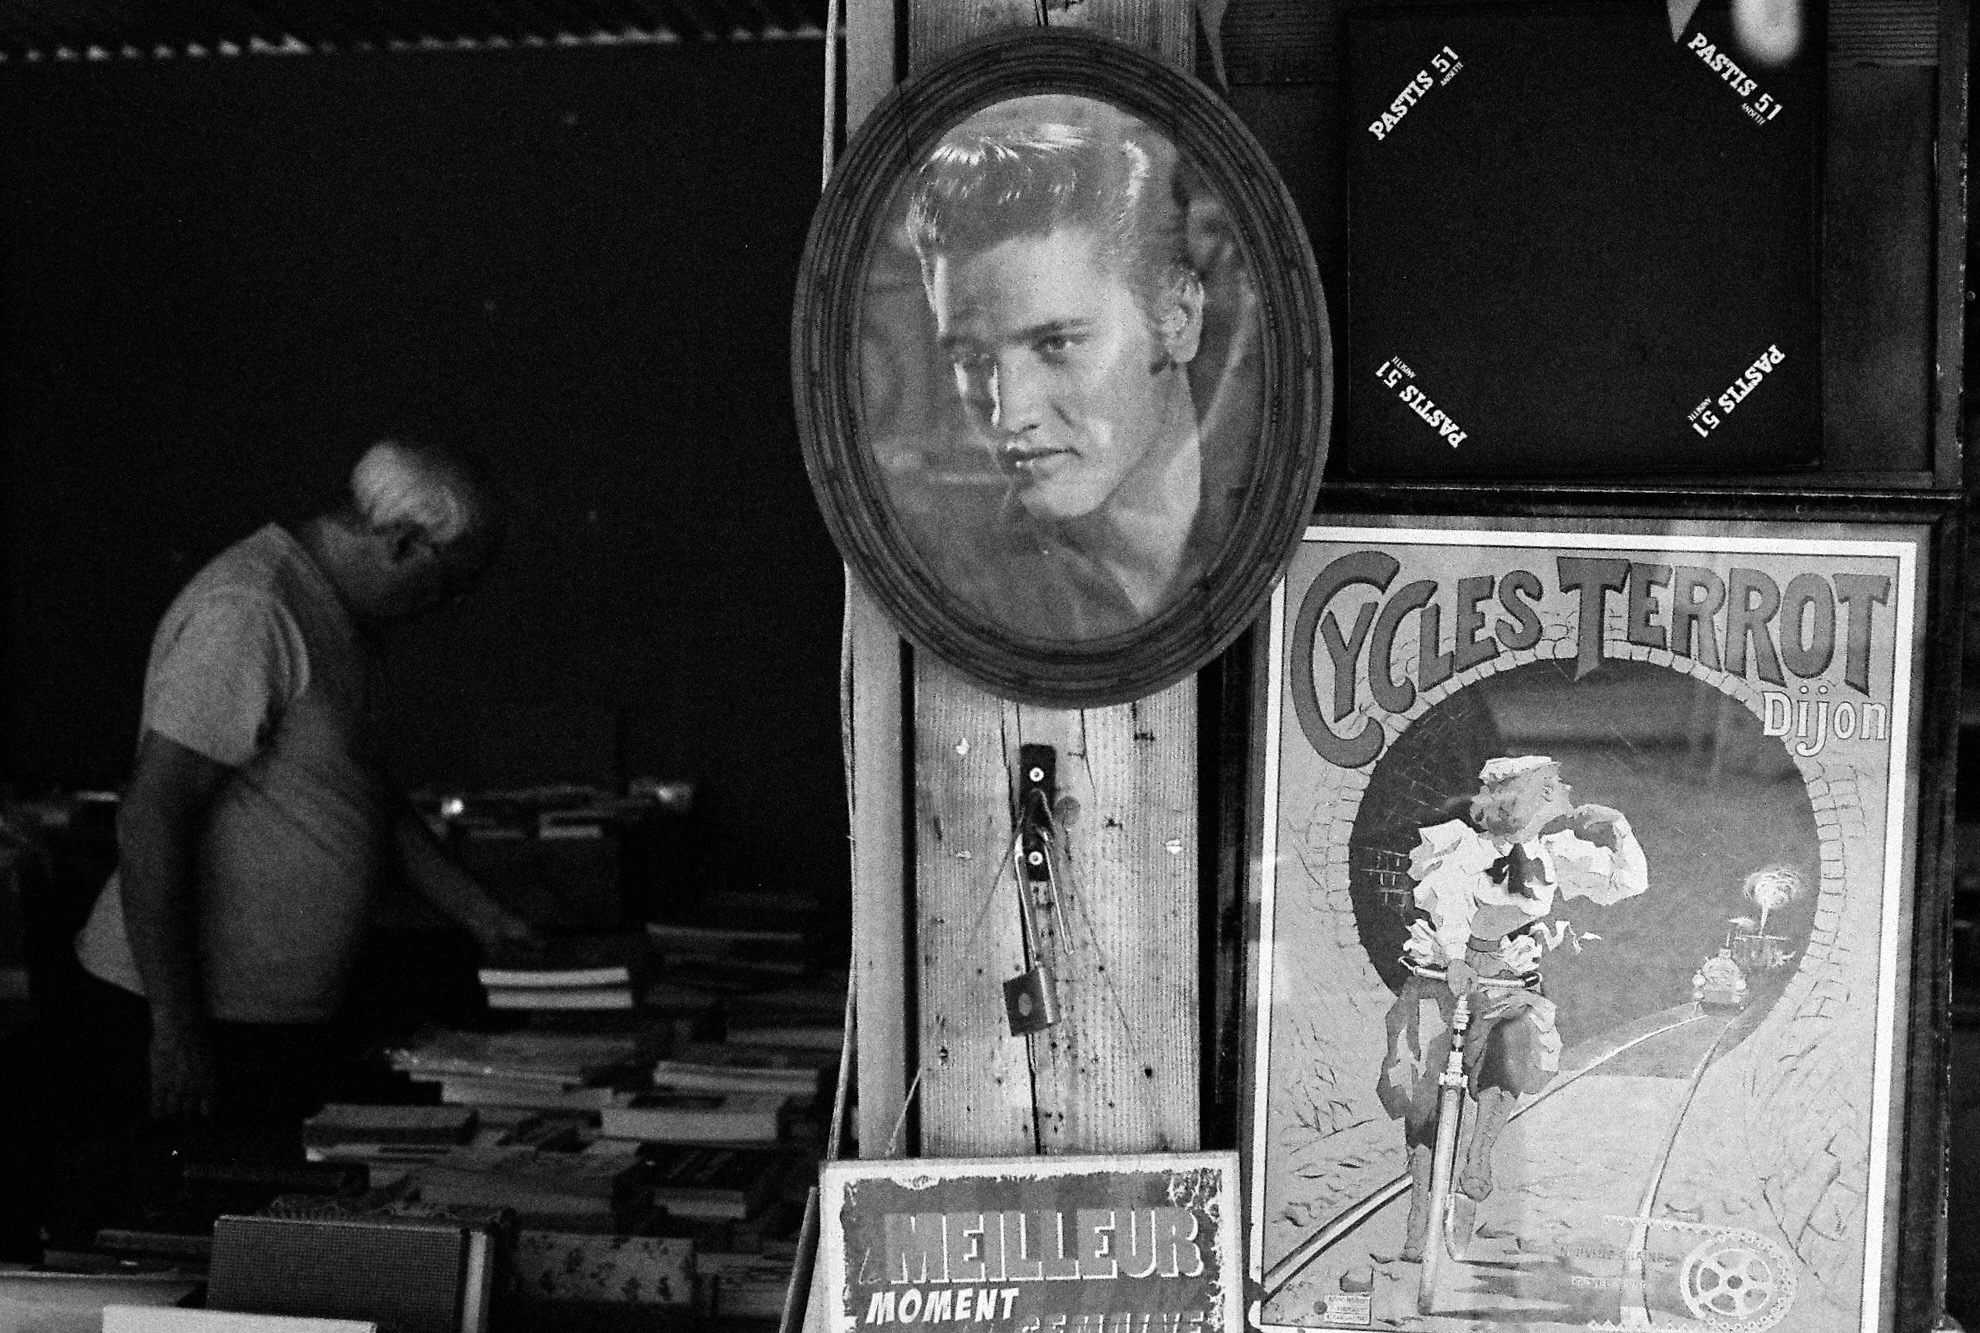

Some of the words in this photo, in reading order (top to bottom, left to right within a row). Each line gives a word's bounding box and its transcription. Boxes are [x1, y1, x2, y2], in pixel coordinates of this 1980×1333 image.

[1368, 69, 1434, 141] PASTIS
[1431, 46, 1459, 73] 51
[1687, 32, 1758, 97] PASTIS
[1754, 93, 1783, 121] 51
[1375, 361, 1402, 388] 51
[1718, 344, 1786, 414] PASTIS
[1399, 385, 1468, 449] PASTIS
[1692, 410, 1720, 438] 51
[1290, 550, 1544, 769] CYCLES
[1556, 556, 1892, 698] TERROT
[1762, 684, 1888, 757] Dijon
[884, 1209, 1204, 1285] MEILLEUR
[865, 1287, 1020, 1326] MOMENT
